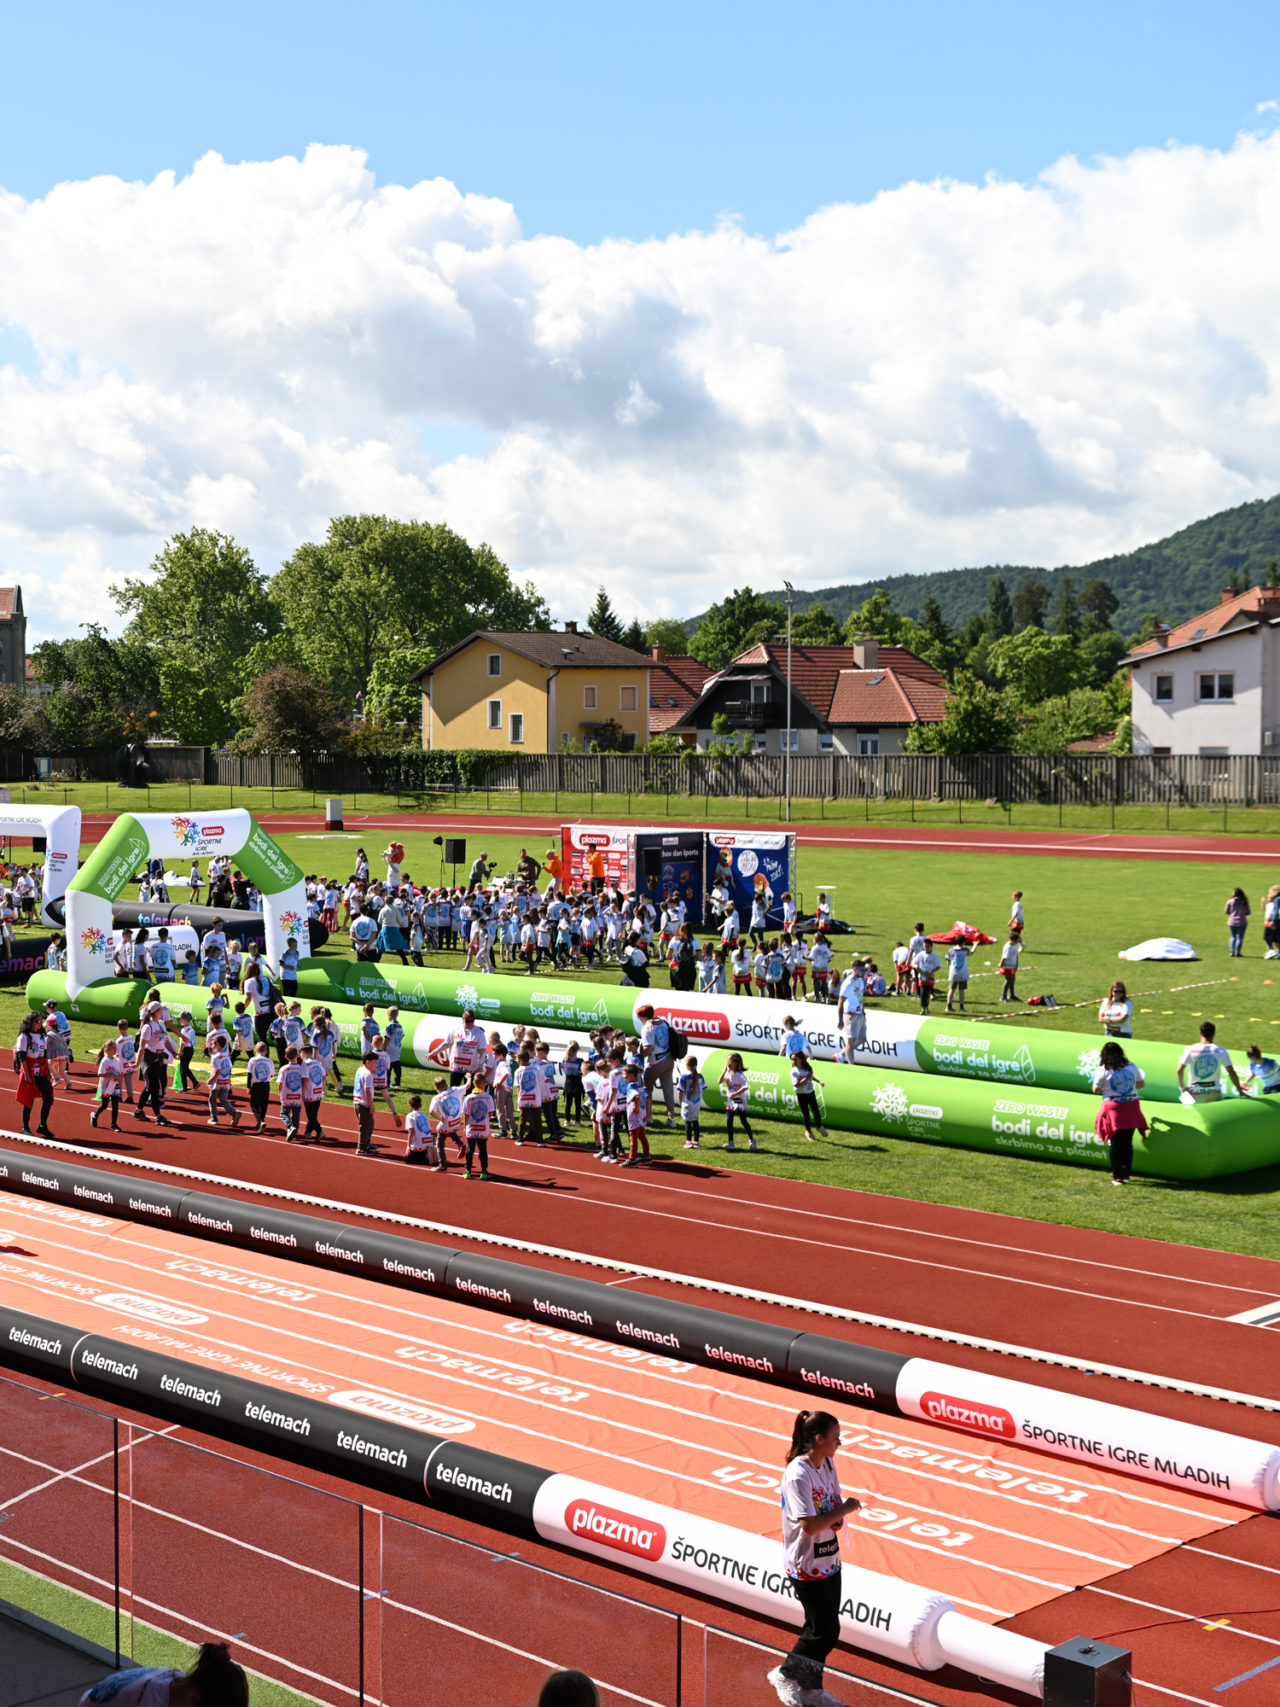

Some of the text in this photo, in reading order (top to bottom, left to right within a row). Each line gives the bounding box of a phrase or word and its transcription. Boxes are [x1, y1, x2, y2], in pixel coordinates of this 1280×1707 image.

[582, 836, 607, 845] plazma
[359, 987, 380, 1000] bodi
[382, 989, 397, 1001] del
[398, 991, 418, 1006] igre
[530, 992, 576, 1004] ZERO WASTE
[530, 1003, 554, 1017] bodi
[557, 1006, 574, 1019] del
[577, 1008, 599, 1023] igre
[934, 1034, 990, 1051] ZERO WASTE
[932, 1048, 1021, 1073] bodi del igre
[755, 1087, 777, 1104] del
[993, 1099, 1069, 1120] ZERO WASTE
[992, 1116, 1107, 1150] bodi del igre
[995, 1136, 1108, 1164] skrbimo za planet
[21, 1171, 59, 1191] telemach
[73, 1184, 113, 1204] telemach
[129, 1198, 172, 1218] telemach
[188, 1211, 233, 1233] telemach
[250, 1226, 297, 1247] telemach
[315, 1240, 364, 1264] telemach
[18, 1266, 102, 1297] ŠPORTNE
[164, 1259, 317, 1303] telemach
[383, 1258, 435, 1282] telemach
[456, 1276, 511, 1303] telemach
[533, 1298, 593, 1326] telemach
[8, 1326, 62, 1355] telemach
[503, 1319, 697, 1373] telemach
[616, 1320, 680, 1349] telemach
[81, 1349, 138, 1380] telemach
[113, 1324, 335, 1395] ŠPORTNE IGRE MLADIH
[704, 1343, 774, 1373] telemach
[395, 1346, 590, 1402] telemach
[800, 1368, 875, 1399] telemach
[160, 1374, 222, 1407] telemach
[245, 1401, 311, 1436] telemach
[352, 1393, 465, 1430] plazma
[336, 1430, 408, 1468] telemach
[928, 1398, 1231, 1491] plazma ŠPORTNE IGRE MLADIH
[838, 1428, 1088, 1503] telemach
[435, 1462, 513, 1503] telemach
[572, 1507, 652, 1550] plazma
[671, 1535, 758, 1588] ŠPORTNE
[761, 1569, 801, 1601] IGR
